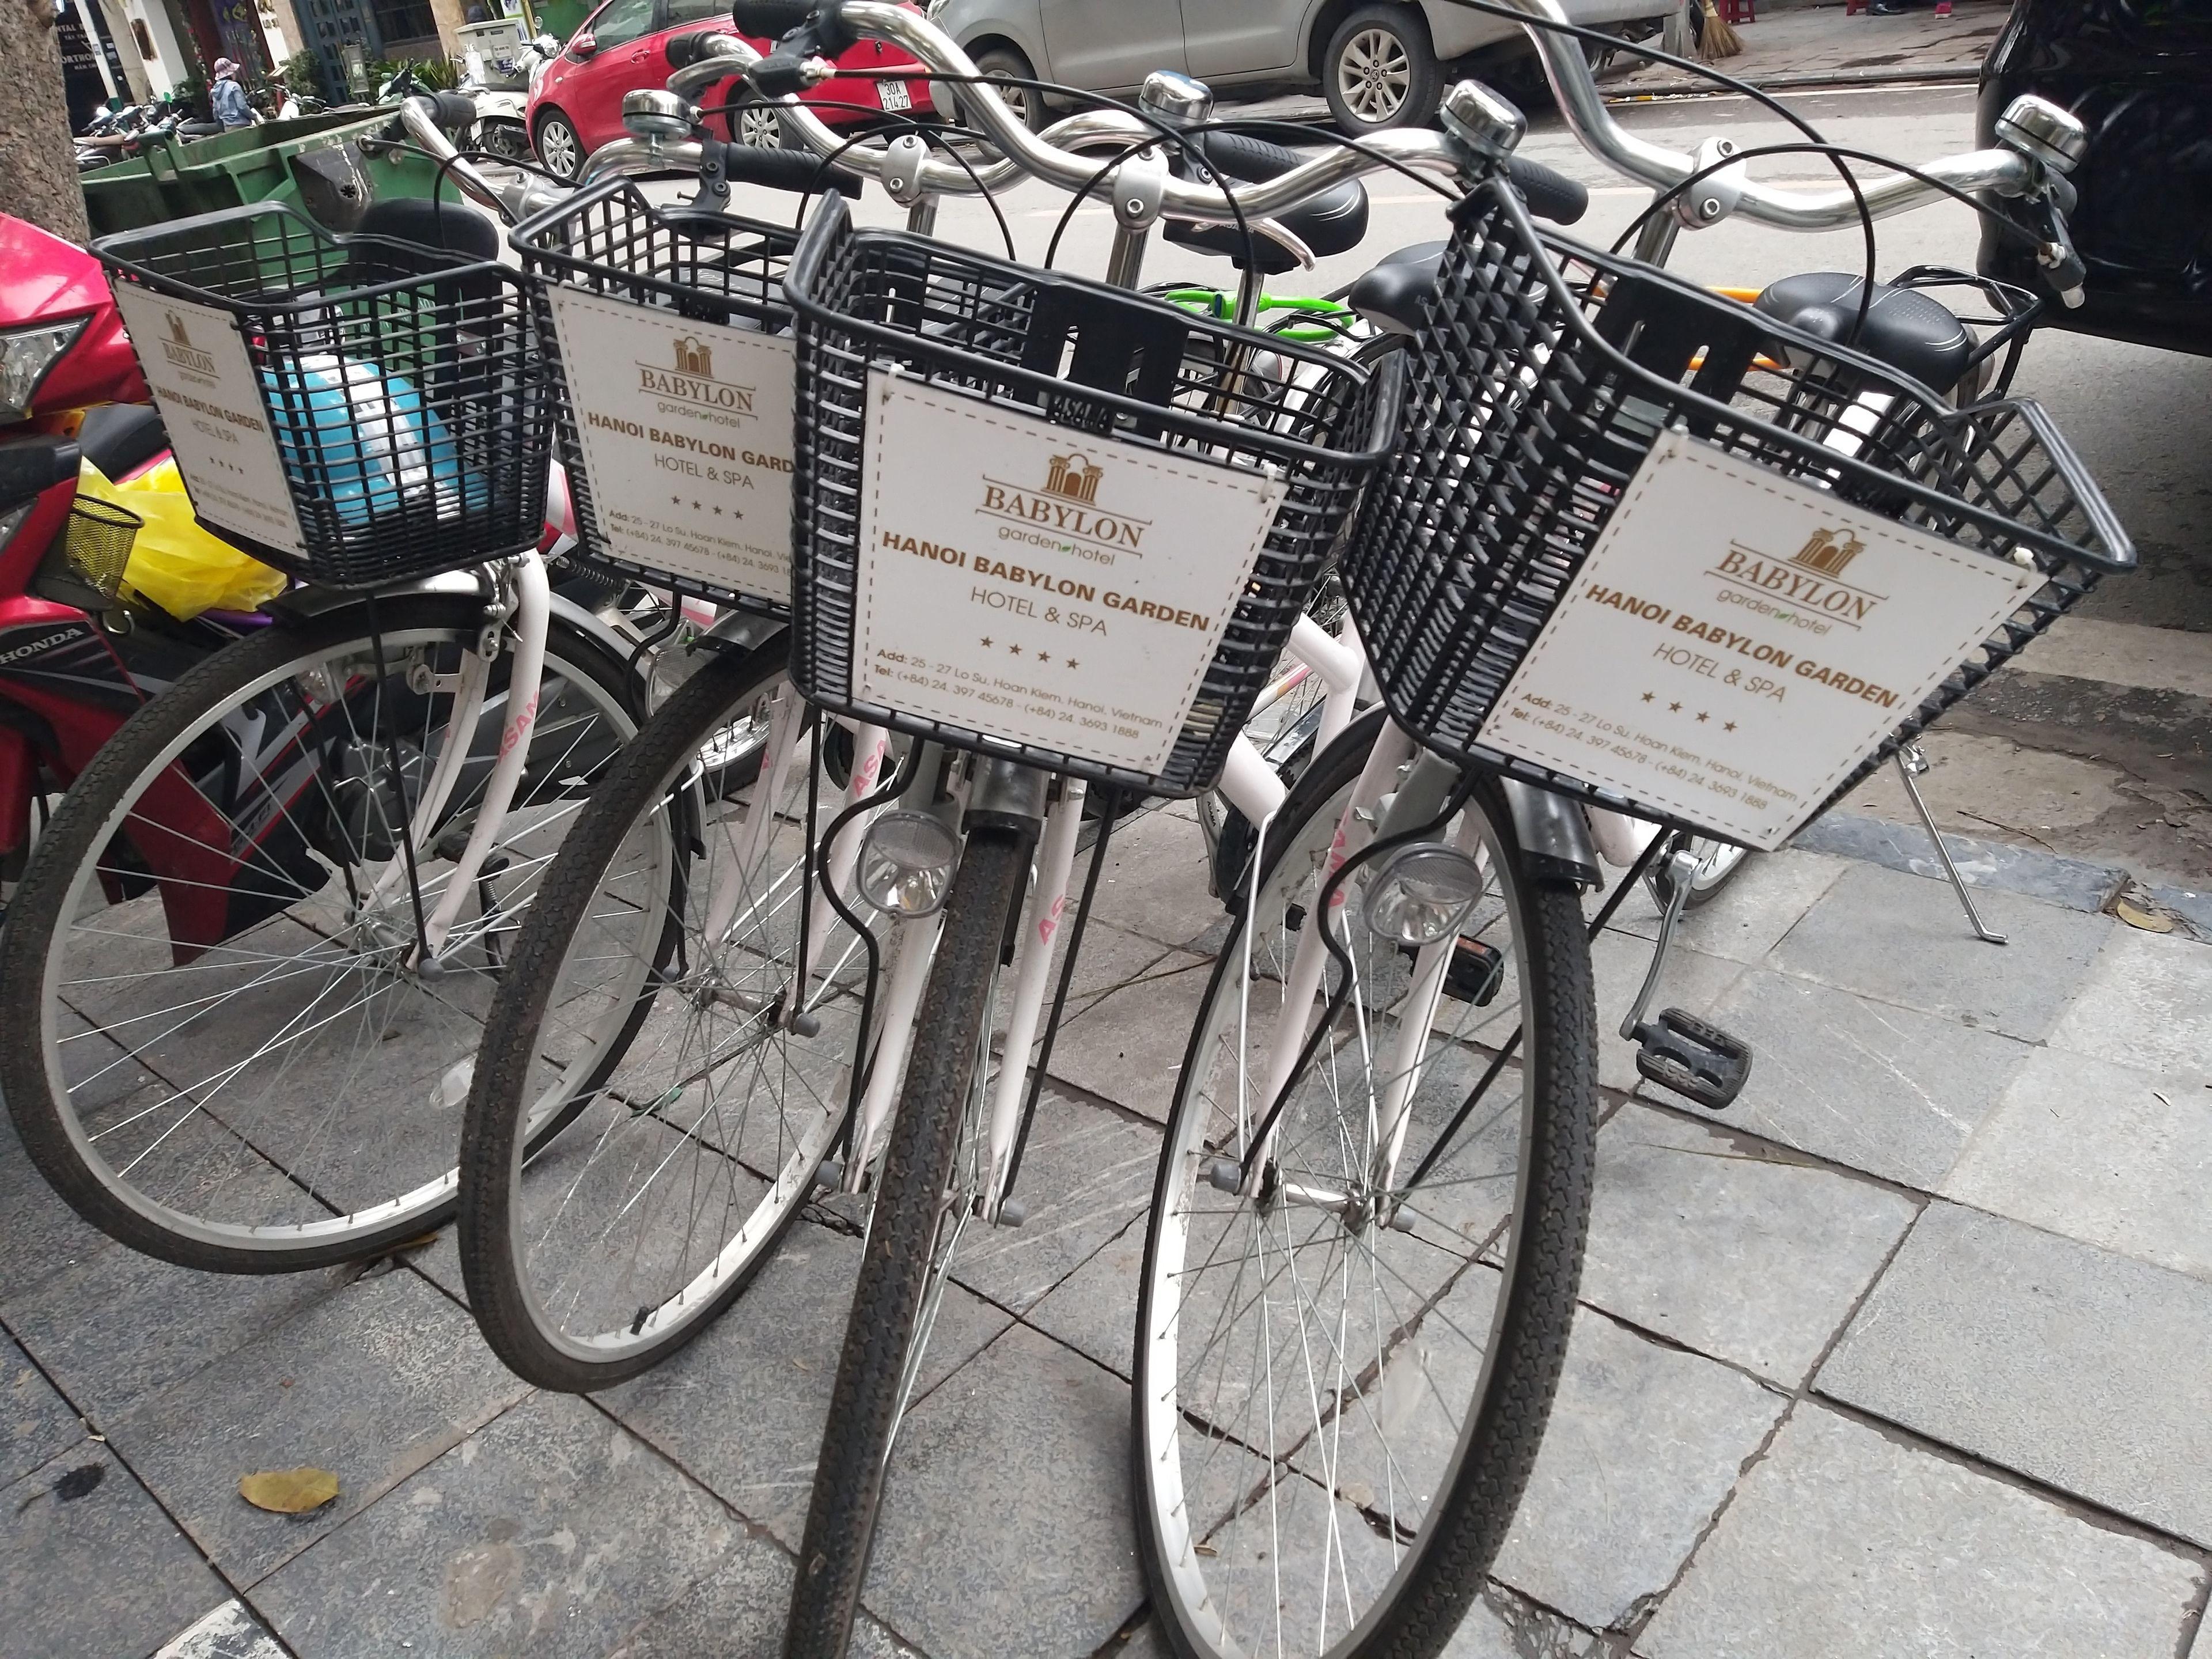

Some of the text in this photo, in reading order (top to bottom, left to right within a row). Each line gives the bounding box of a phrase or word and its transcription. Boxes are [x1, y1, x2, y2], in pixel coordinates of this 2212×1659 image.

[883, 95, 908, 109] 214.27
[884, 82, 901, 95] 30A
[639, 369, 752, 411] BABYLON
[588, 412, 643, 438] HANOI
[650, 428, 735, 460] BABYLON
[657, 402, 740, 428] garden hotel
[654, 454, 754, 490] HOTEL & SPA
[691, 529, 715, 543] Hoan
[983, 485, 1145, 548] BABYLON
[666, 538, 680, 547] 397
[717, 551, 740, 564] (+84)
[758, 561, 779, 573] 3693
[998, 527, 1115, 566] garden hotel
[882, 531, 1209, 631] HANOI BABYLON GARDEN
[1715, 550, 1877, 620] BABYLON
[971, 586, 1107, 636] HOTEL & SPA
[1716, 589, 1833, 636] garden hotel
[0, 628, 84, 665] HONDA
[1585, 584, 1899, 708] HANOI BABYLON GARDEN
[877, 649, 907, 663] Add:
[911, 657, 926, 668] 25
[936, 664, 952, 674] 27
[955, 668, 969, 679] Lo
[994, 678, 1027, 694] Hoan
[1112, 707, 1162, 728] Vietnam
[1653, 642, 1786, 703] HOTEL & SPA
[874, 664, 893, 677] Tel:
[897, 671, 929, 687] (+84)
[953, 685, 975, 697] 397
[978, 692, 1013, 708] 45678
[1024, 704, 1055, 719] (+84)
[1080, 717, 1107, 731] 3693
[1113, 725, 1139, 738] 1888
[1510, 707, 1531, 721] Tel:
[1532, 716, 1565, 734] (+84)
[1586, 736, 1611, 748] 397
[1611, 745, 1647, 764] 45678
[1655, 762, 1687, 779] (+84)
[1707, 781, 1738, 798] 3693
[1521, 694, 1552, 709] Add:
[1554, 704, 1572, 715] 25
[1578, 713, 1597, 724] 27
[1596, 719, 1612, 731] Lo
[1634, 733, 1668, 751] Hoan
[1748, 775, 1798, 802] Vietnam
